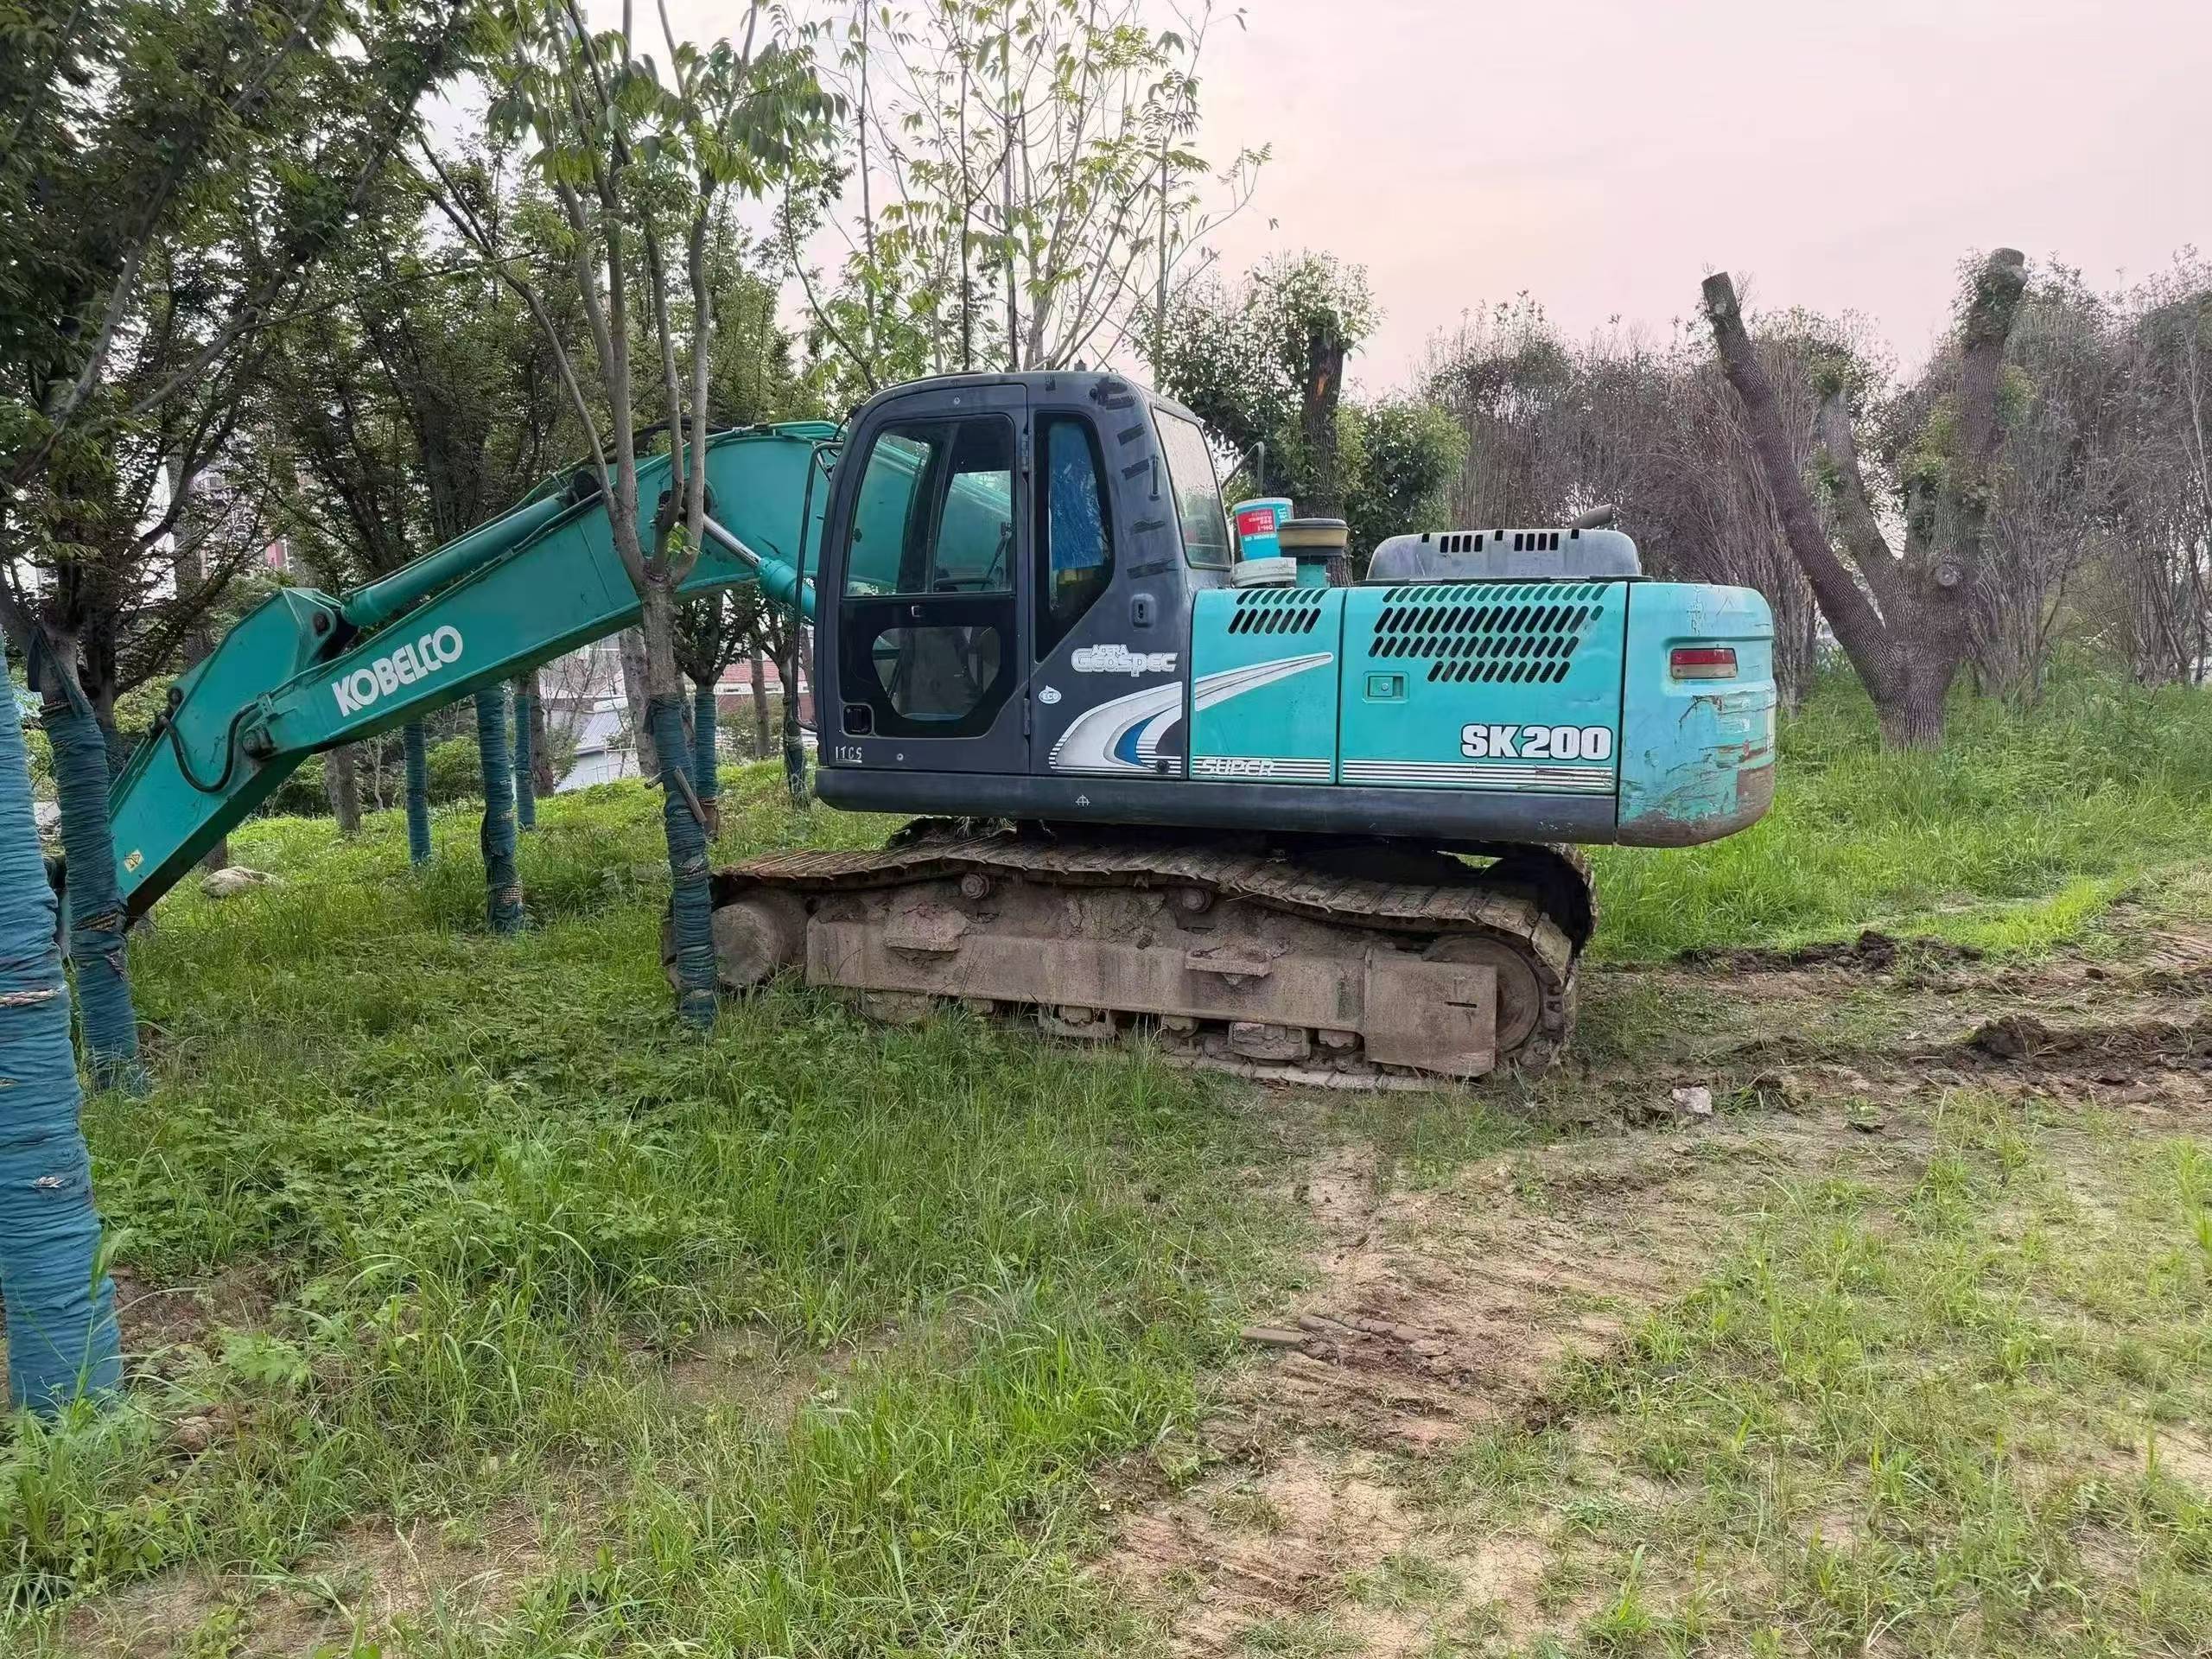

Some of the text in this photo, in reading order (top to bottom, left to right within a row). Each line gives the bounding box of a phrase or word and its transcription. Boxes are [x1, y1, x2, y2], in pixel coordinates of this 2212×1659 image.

[332, 625, 463, 717] KOBELCO
[1460, 723, 1612, 760] SK200
[1201, 759, 1274, 776] SUPER
